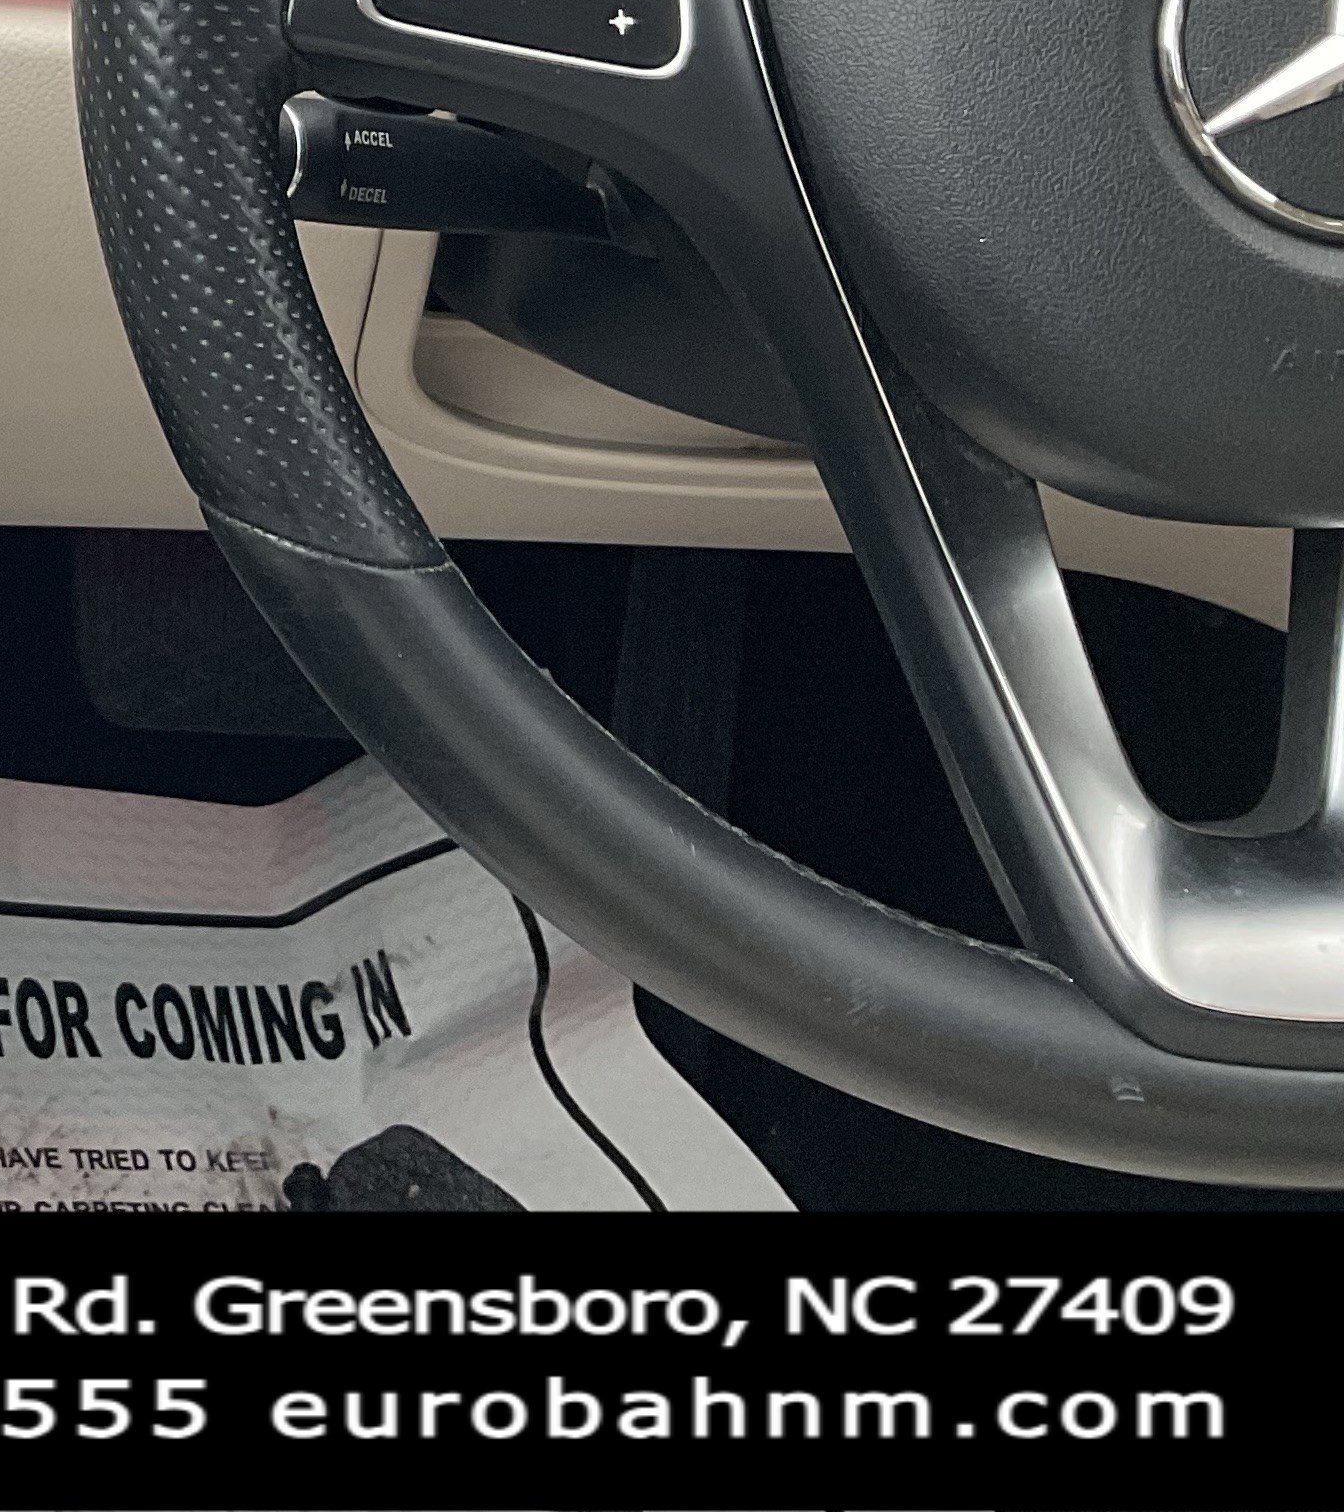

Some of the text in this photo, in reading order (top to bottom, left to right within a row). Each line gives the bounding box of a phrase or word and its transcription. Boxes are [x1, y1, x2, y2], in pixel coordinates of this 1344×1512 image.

[354, 129, 394, 148] ACCEL
[348, 186, 388, 204] DECEL
[114, 981, 346, 1066] COMING
[350, 948, 412, 1051] IN
[69, 1148, 149, 1172] TRIED
[158, 1149, 196, 1172] TO
